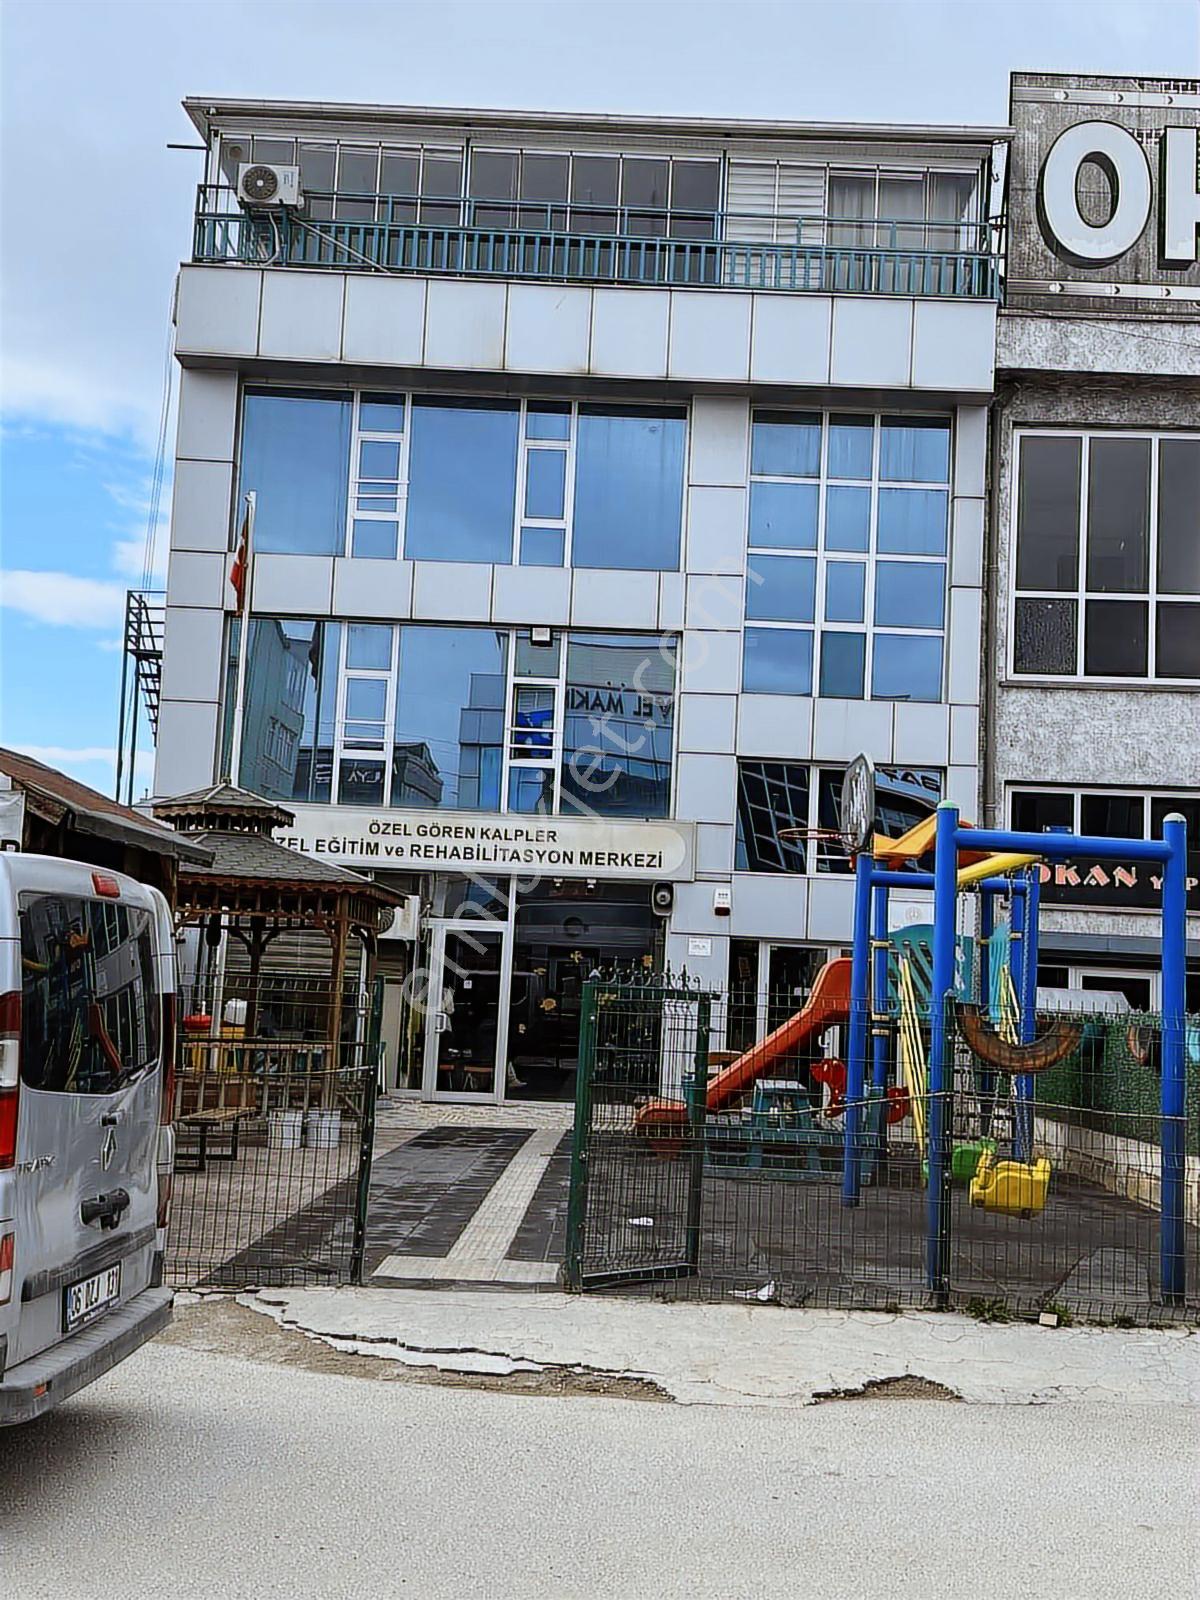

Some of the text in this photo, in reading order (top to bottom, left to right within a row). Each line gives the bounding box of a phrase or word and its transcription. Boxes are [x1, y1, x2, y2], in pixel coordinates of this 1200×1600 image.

[368, 819, 557, 843] ÖZEL GÖREN KALPLER
[275, 836, 662, 868] ZEL EĞİTİM ve REHABİLİTASYON MERKEZİ
[1150, 875, 1199, 891] YP
